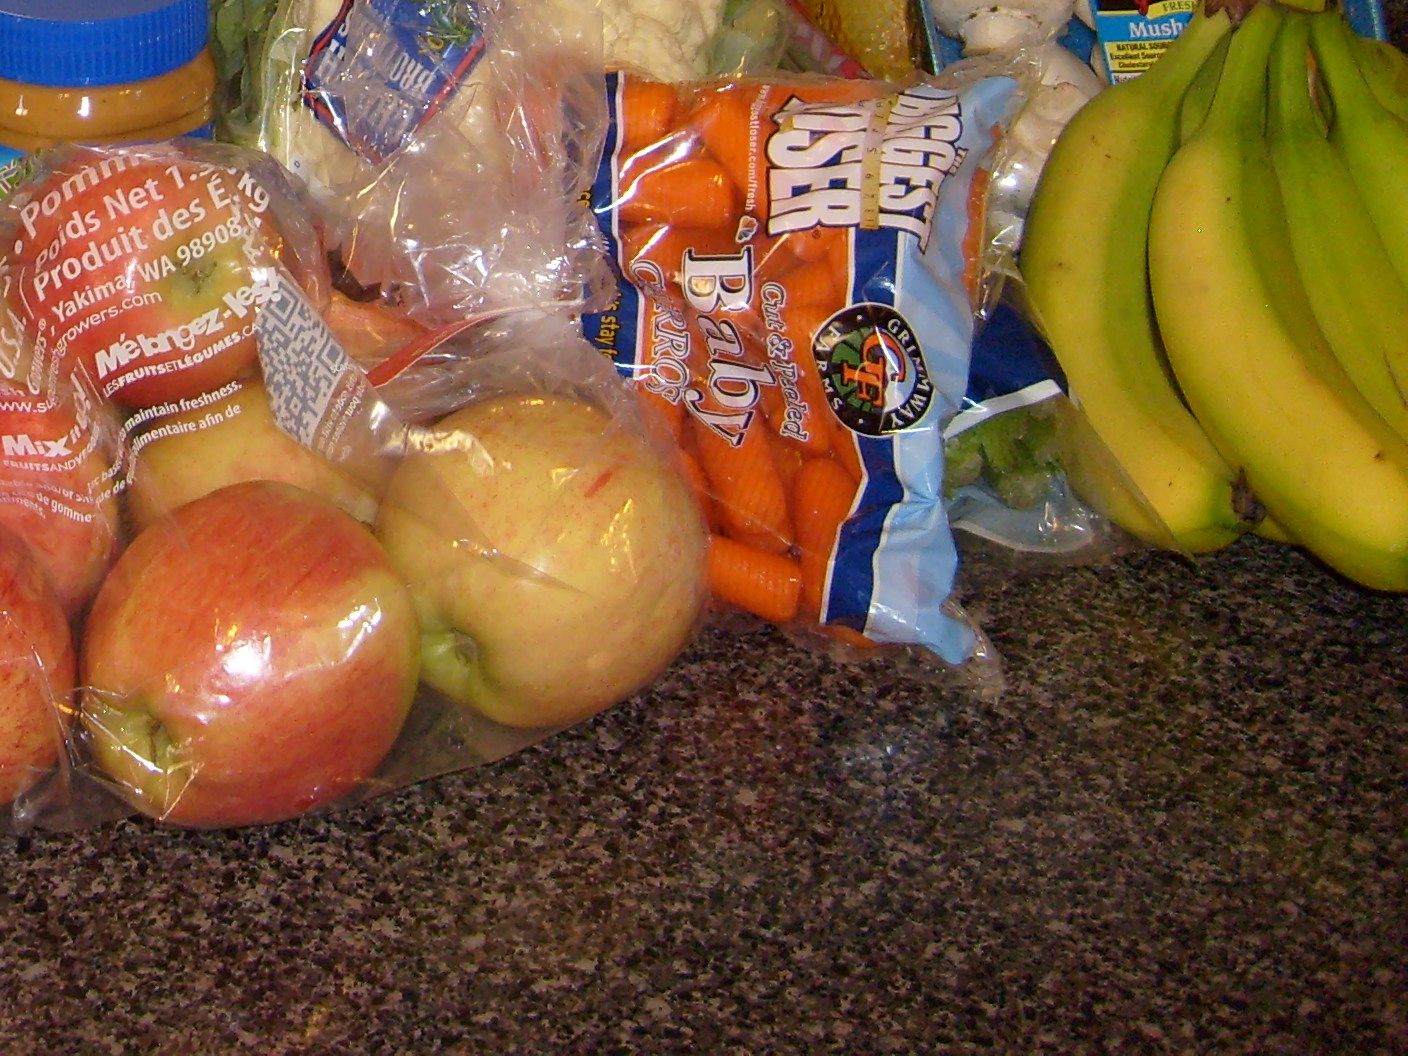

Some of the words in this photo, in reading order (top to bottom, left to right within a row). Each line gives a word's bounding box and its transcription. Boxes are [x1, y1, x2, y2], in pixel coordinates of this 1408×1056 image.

[32, 224, 149, 304] Produit
[152, 197, 208, 242] des
[35, 208, 102, 274] Poids
[103, 177, 165, 221] Net
[138, 258, 178, 283] WA
[176, 216, 243, 267] 98908
[681, 245, 776, 447] Baby
[886, 317, 935, 430] GRIMMWAY
[1, 433, 74, 458] Mix
[124, 400, 180, 429] maintain
[199, 412, 224, 429] afin
[226, 403, 242, 419] de
